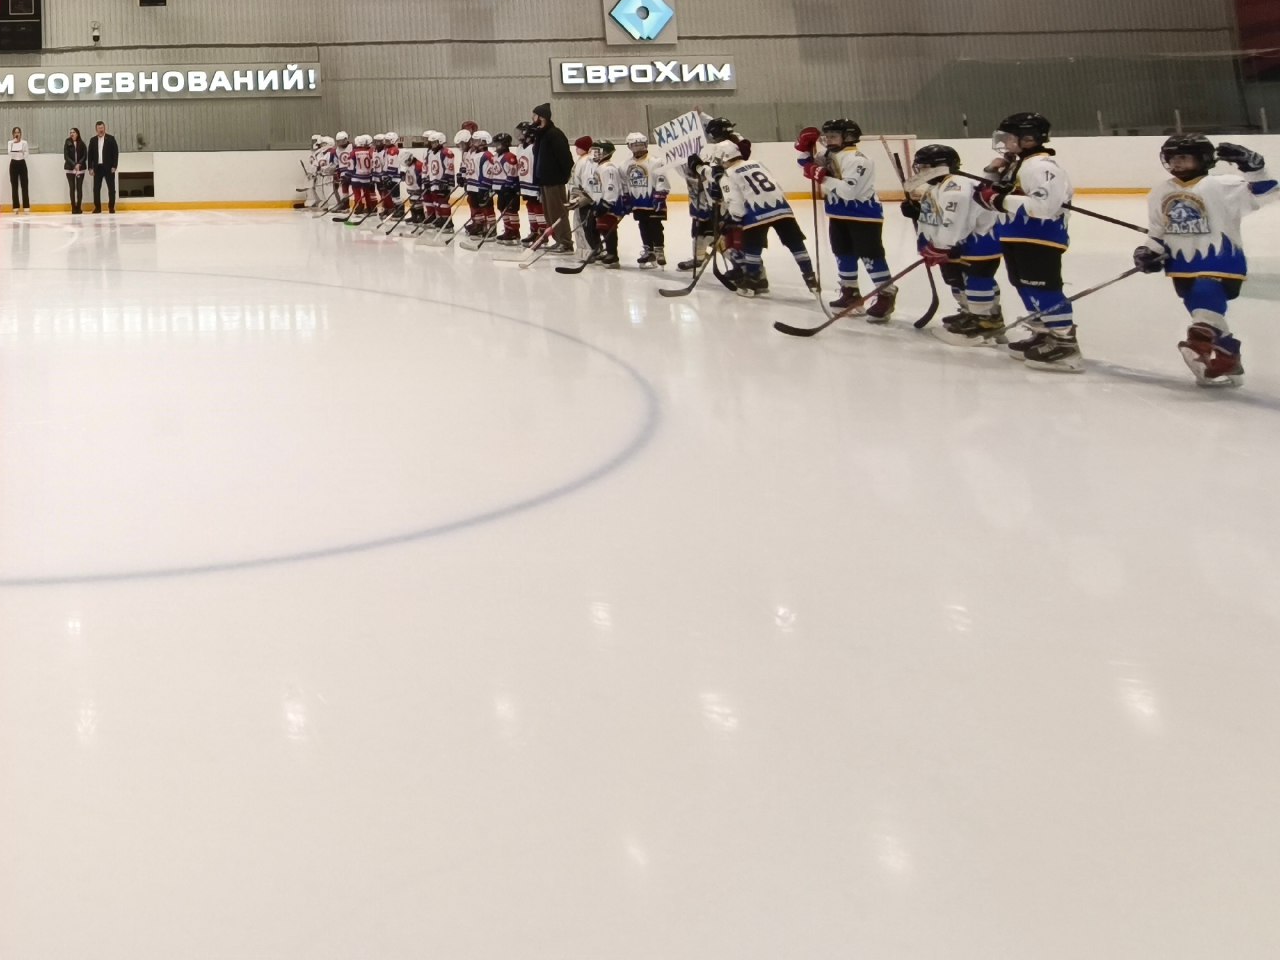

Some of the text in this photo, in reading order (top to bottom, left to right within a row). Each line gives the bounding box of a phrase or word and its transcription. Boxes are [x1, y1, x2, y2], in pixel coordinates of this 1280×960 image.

[27, 64, 316, 95] СОРЕВНОВАНИЙ!
[654, 112, 699, 148] ХАСКИ
[744, 171, 776, 196] 18
